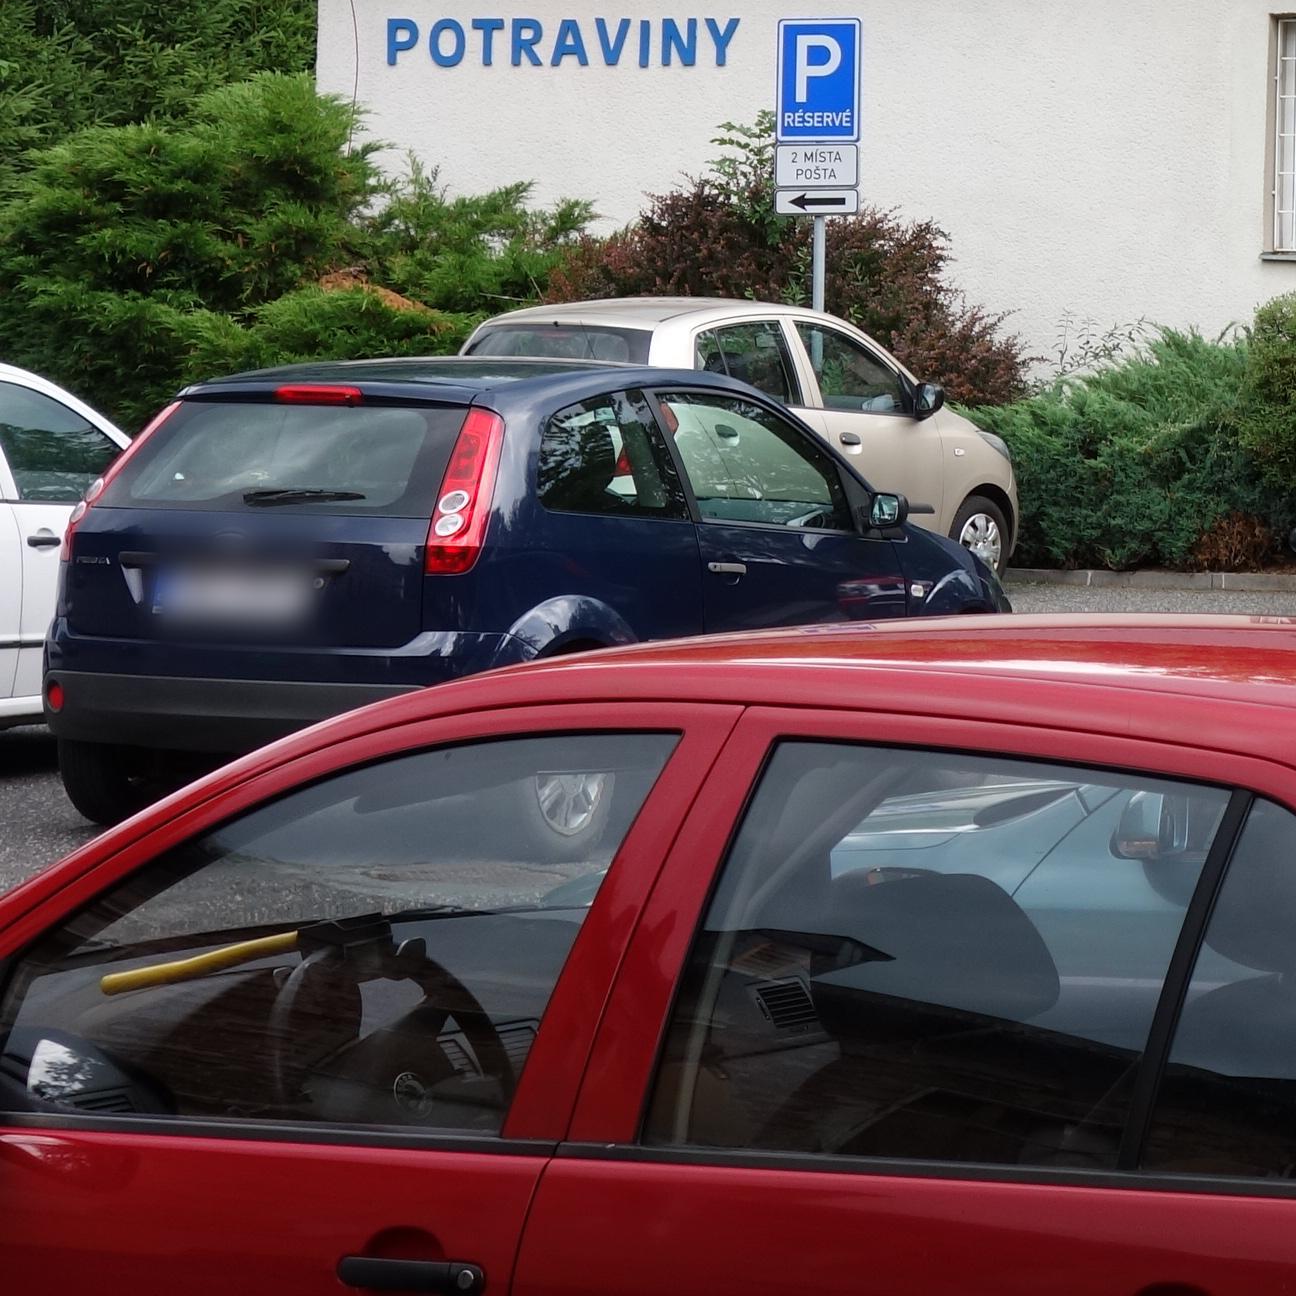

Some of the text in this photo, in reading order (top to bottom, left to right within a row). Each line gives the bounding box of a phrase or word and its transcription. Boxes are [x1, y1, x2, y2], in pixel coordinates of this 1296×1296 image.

[386, 17, 741, 68] POTRAVINY
[794, 34, 842, 103] P
[784, 108, 852, 128] RÉSERVÉ
[791, 148, 842, 164] 2 MÍSTA
[795, 164, 837, 181] POŠTA
